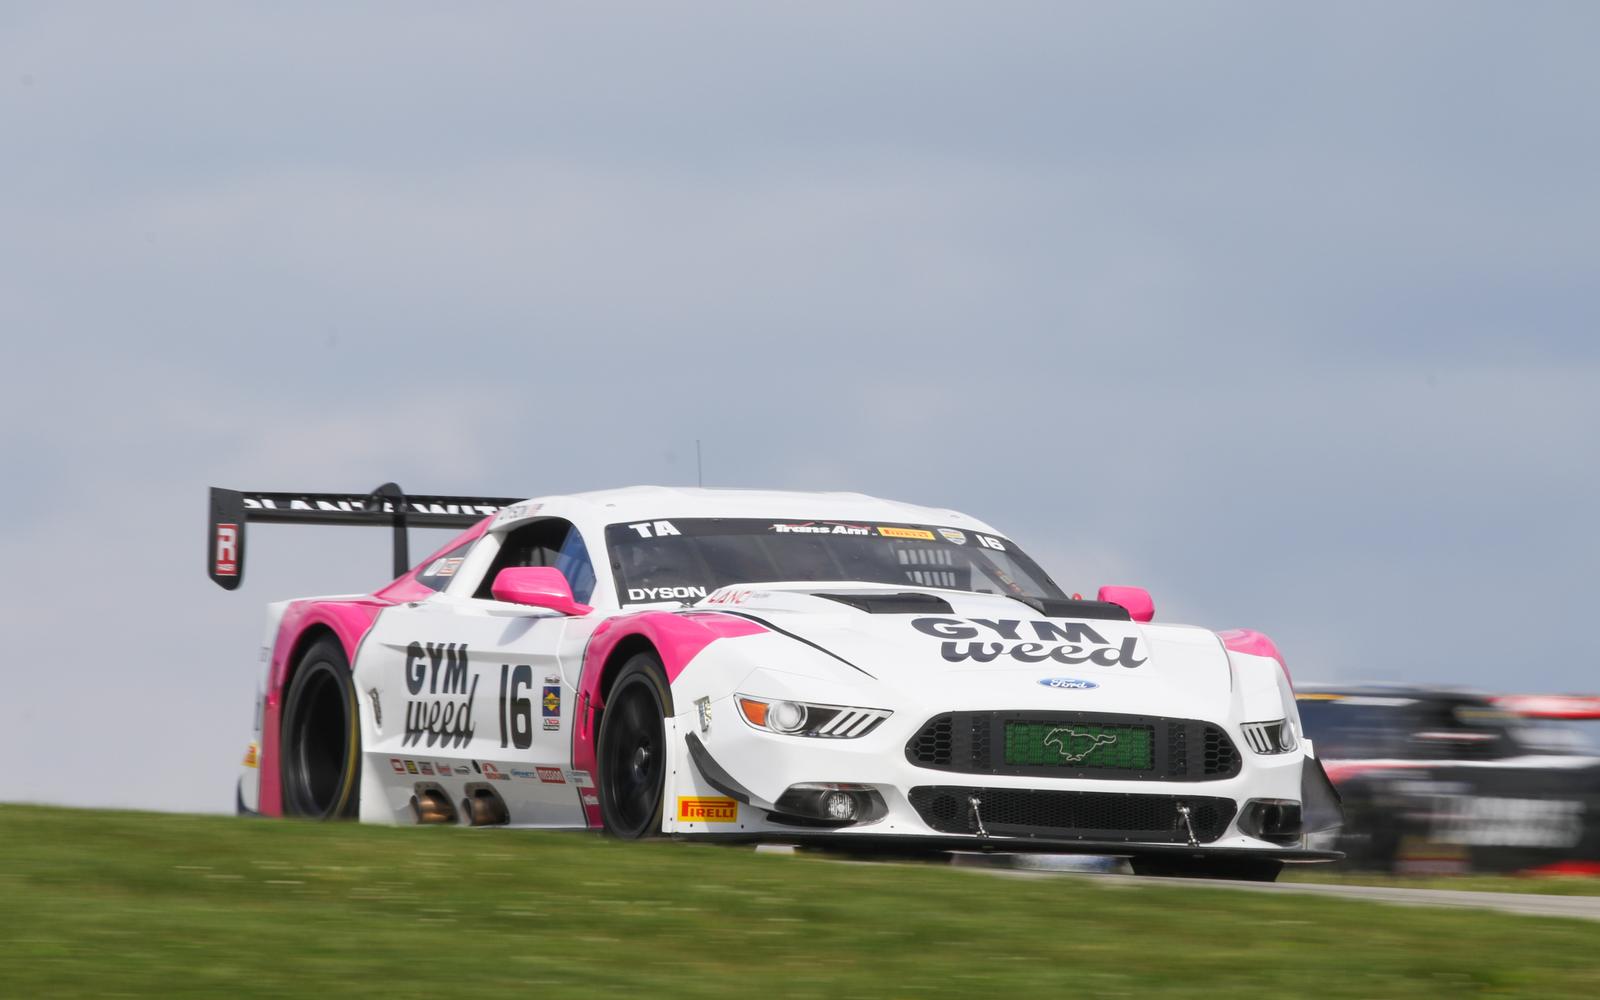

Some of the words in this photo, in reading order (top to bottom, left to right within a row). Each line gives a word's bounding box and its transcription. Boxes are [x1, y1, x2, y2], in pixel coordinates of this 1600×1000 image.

[628, 520, 682, 538] TA
[773, 524, 830, 533] Trans
[831, 525, 868, 536] Am
[883, 529, 930, 538] PIRELLI
[975, 534, 1006, 551] 16
[627, 586, 707, 601] DYSON
[910, 617, 1111, 644] GYM
[940, 637, 1149, 668] weed
[405, 641, 469, 695] GYM
[1050, 678, 1088, 689] Ford
[401, 674, 480, 749] weed
[499, 664, 532, 749] 16
[681, 800, 736, 818] PIRELLI
